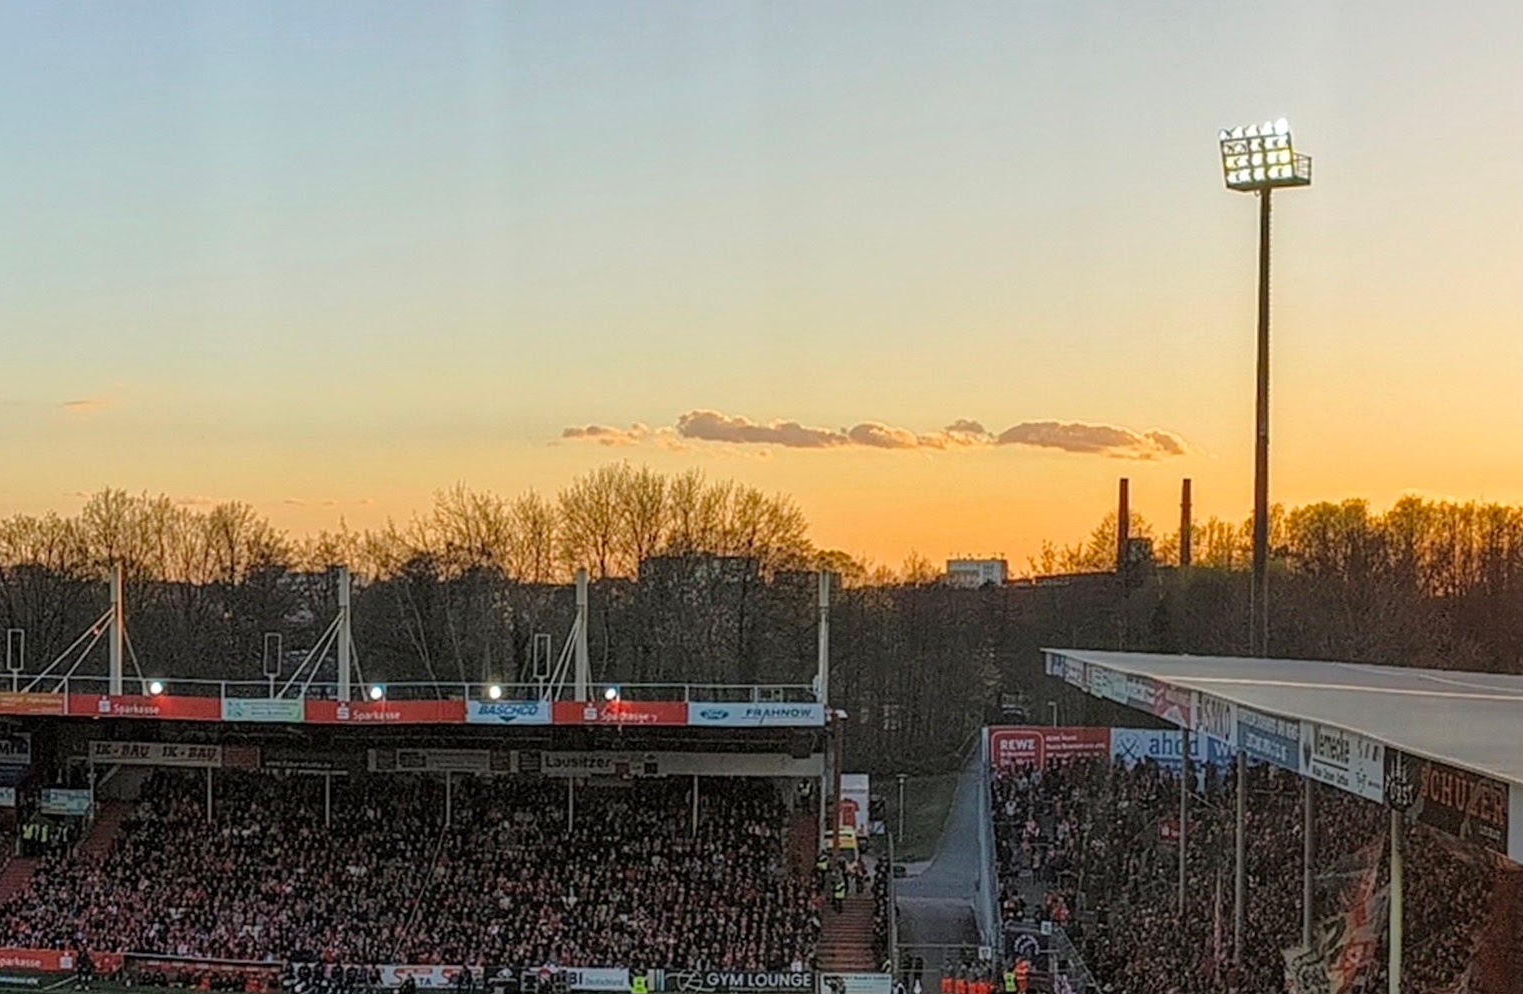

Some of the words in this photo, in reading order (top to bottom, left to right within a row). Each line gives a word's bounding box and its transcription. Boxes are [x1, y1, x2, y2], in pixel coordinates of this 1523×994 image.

[113, 703, 161, 716] Sparkasse
[352, 709, 401, 722] Sparkasse
[477, 704, 540, 717] BASCHCO
[745, 708, 812, 719] FRAHNOW
[545, 753, 613, 768] Lausitzer
[707, 972, 744, 987] GYM
[747, 972, 812, 988] LOUNGE
